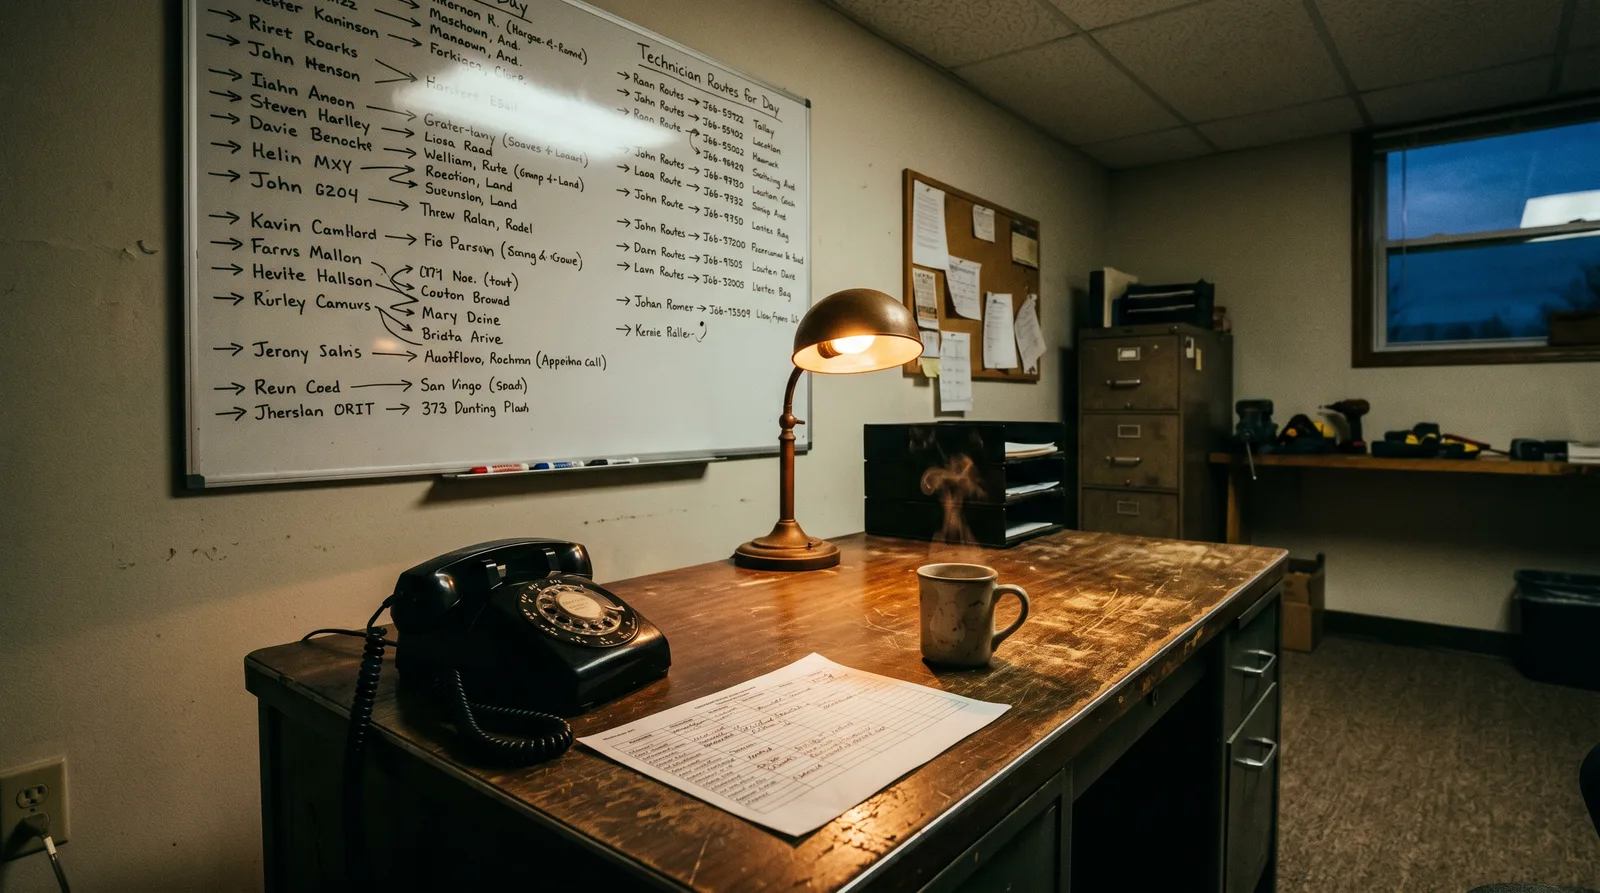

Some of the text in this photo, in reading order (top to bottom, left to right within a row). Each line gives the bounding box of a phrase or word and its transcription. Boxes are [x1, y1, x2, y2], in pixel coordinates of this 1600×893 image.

[249, 14, 359, 59] Riret Roarks
[497, 34, 522, 52] And.
[248, 40, 360, 82] John Henson
[496, 50, 522, 68] And.
[637, 42, 779, 119] Technician Routes for Day
[660, 83, 684, 101] Routes
[251, 94, 370, 137] Steven Harlley
[660, 101, 684, 118] Routes
[250, 115, 298, 137] Davie
[660, 118, 681, 132] Route
[253, 142, 352, 174] Helin MXY
[424, 148, 477, 172] Welliam,
[483, 160, 508, 175] Rute
[660, 153, 684, 169] Routes
[249, 171, 302, 194] John
[486, 178, 512, 192] Land
[660, 173, 682, 187] Route
[490, 195, 517, 210] Land
[635, 190, 657, 203] John
[662, 195, 684, 210] Route
[420, 202, 455, 220] Threw
[251, 211, 301, 233] Kavin
[634, 219, 656, 232] John
[661, 224, 685, 238] Routes
[310, 245, 361, 265] Mallon
[662, 247, 685, 260] Routes
[253, 264, 372, 287] Hevite Hallson
[660, 266, 684, 280] Routes
[421, 285, 510, 306] Couton Browad
[635, 295, 662, 309] Johan
[422, 307, 457, 325] Mary
[471, 331, 503, 345] Arive
[253, 341, 308, 364] Jerony
[306, 380, 341, 394] Coed
[421, 378, 445, 392] San
[452, 378, 482, 396] Vingo
[335, 403, 375, 416] ORIT
[422, 402, 447, 416] 373
[455, 402, 496, 418] Dunting
